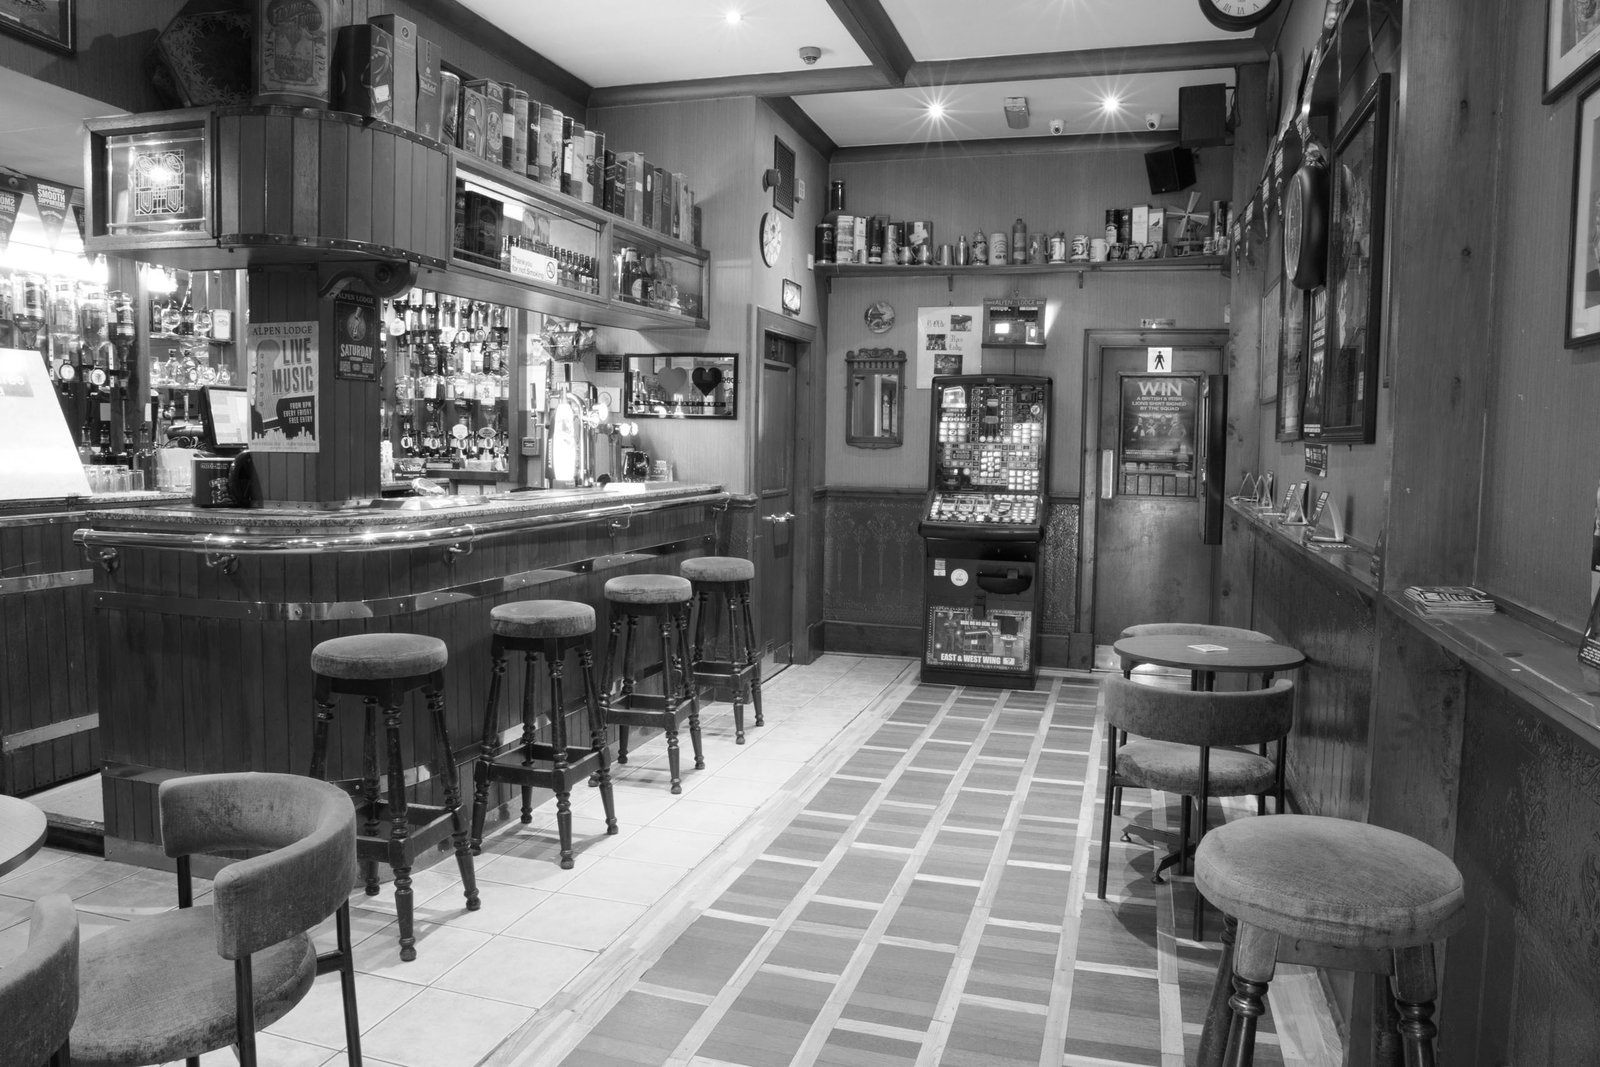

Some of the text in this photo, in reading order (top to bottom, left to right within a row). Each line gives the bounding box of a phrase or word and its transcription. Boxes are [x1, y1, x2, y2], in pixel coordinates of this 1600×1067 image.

[37, 189, 66, 203] SMOOTH
[253, 325, 313, 336] ALPEN LODGE
[282, 337, 312, 365] LIVE
[340, 343, 373, 360] SATURDAY
[272, 365, 314, 393] MUSIC
[1138, 381, 1183, 396] WIN
[940, 653, 957, 661] EAST
[963, 654, 982, 663] WEST
[982, 655, 1001, 665] WING
